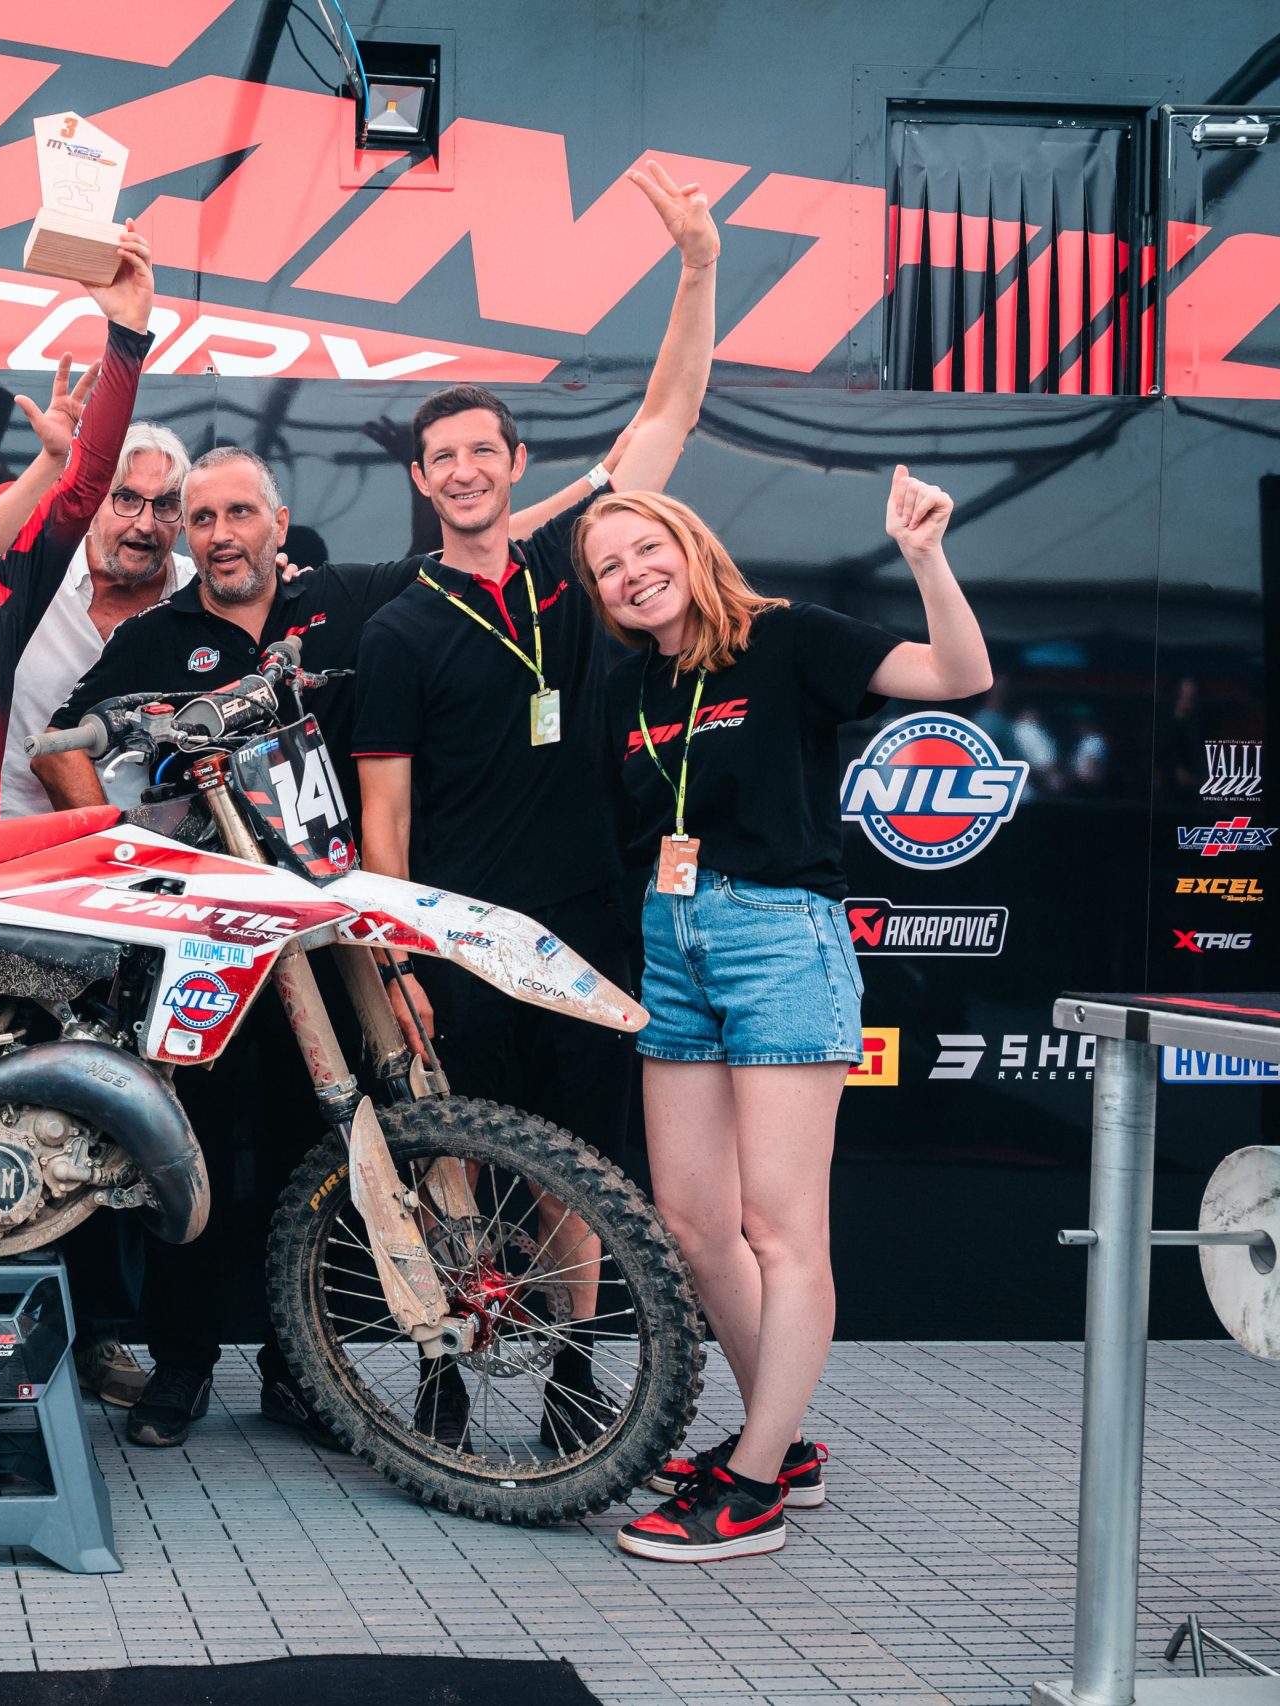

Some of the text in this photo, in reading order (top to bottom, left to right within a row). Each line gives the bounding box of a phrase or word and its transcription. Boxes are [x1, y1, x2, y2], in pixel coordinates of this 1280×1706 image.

[60, 117, 78, 138] 3
[190, 655, 219, 669] NILS
[1205, 744, 1263, 778] VALLI
[846, 768, 1018, 813] NILS
[1177, 827, 1278, 846] VERTEX
[330, 846, 347, 863] NILS
[674, 862, 698, 895] 3
[1175, 878, 1264, 894] EXCEL
[80, 888, 300, 934] FANTIC
[223, 926, 285, 941] RACING
[447, 930, 495, 947] VERTEX
[1172, 928, 1253, 953] XTRIG
[183, 941, 247, 964] AVIOMETAL
[163, 987, 238, 1013] NILS
[85, 1060, 132, 1089] HGS
[998, 1071, 1093, 1080] RACEGE
